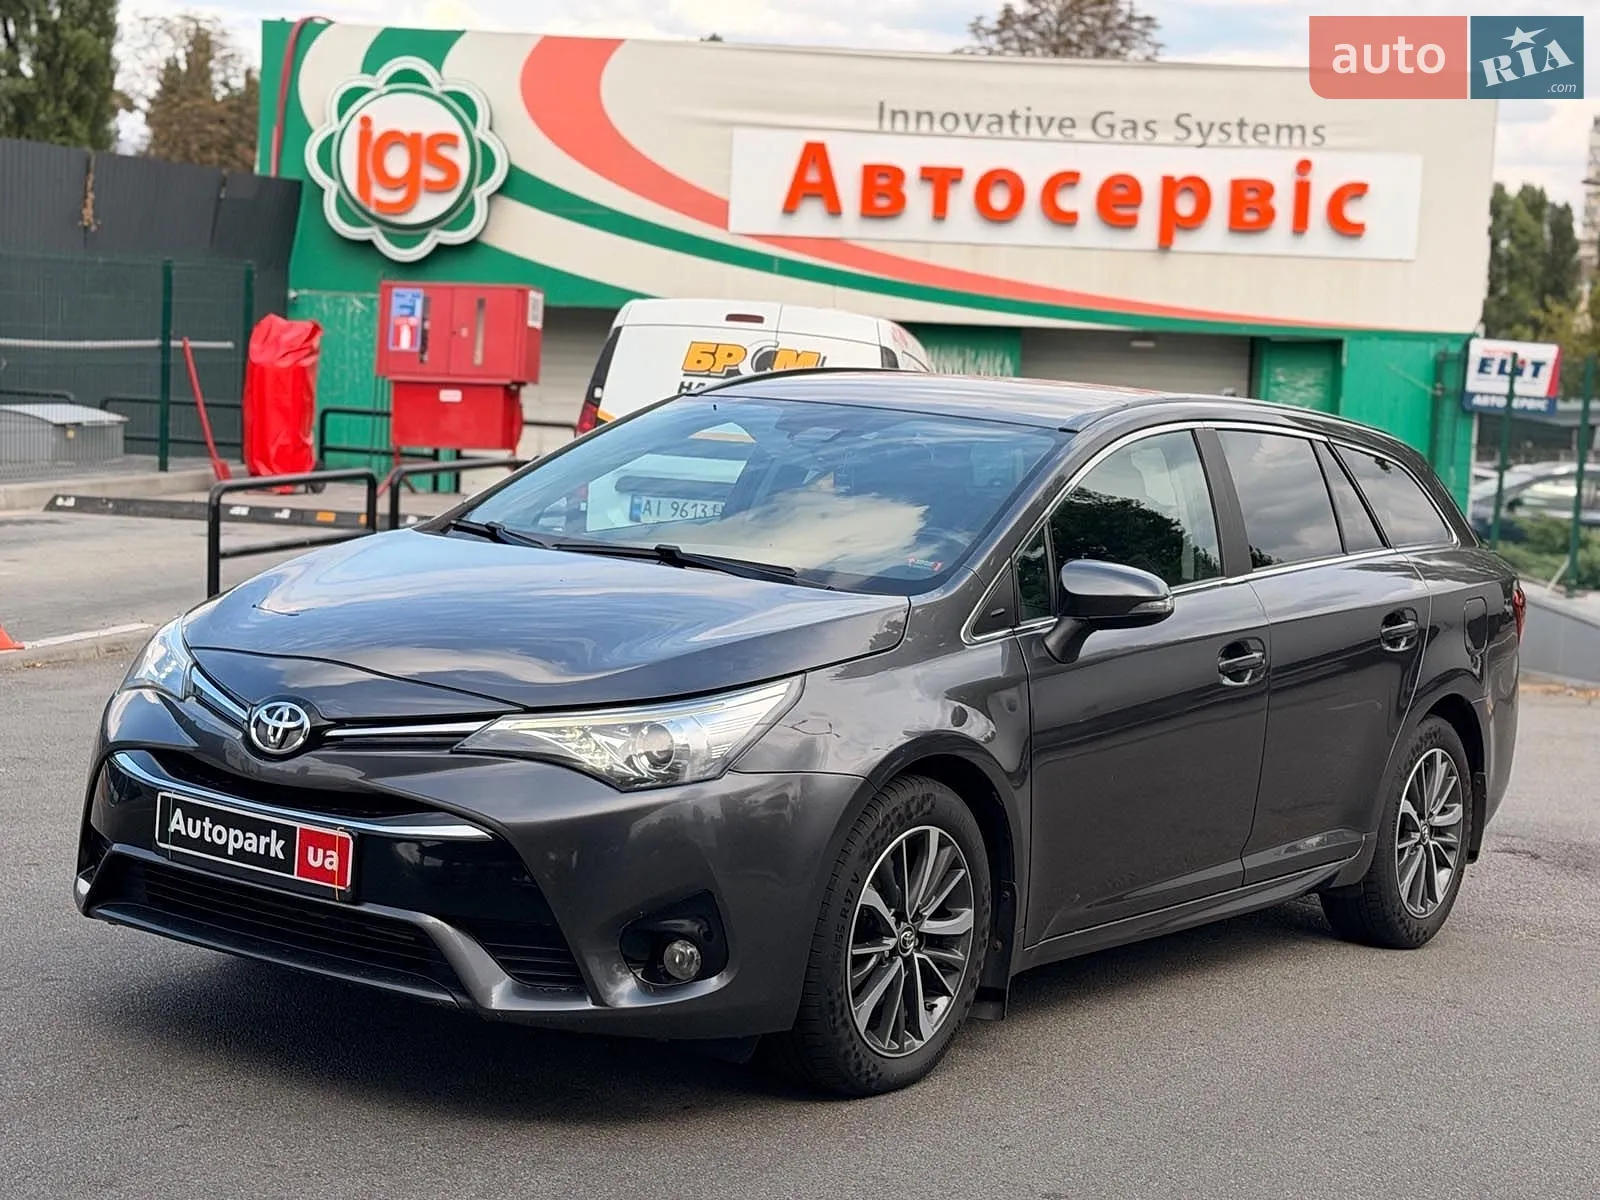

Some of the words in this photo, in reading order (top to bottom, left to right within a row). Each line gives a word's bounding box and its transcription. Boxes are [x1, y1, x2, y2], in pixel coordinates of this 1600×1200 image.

[877, 101, 1077, 138] Innovative
[1091, 111, 1157, 142] Gas
[1174, 113, 1327, 149] Systems
[781, 140, 1370, 249] Автосервіс
[168, 808, 286, 860] Autopark
[307, 846, 339, 871] ua
